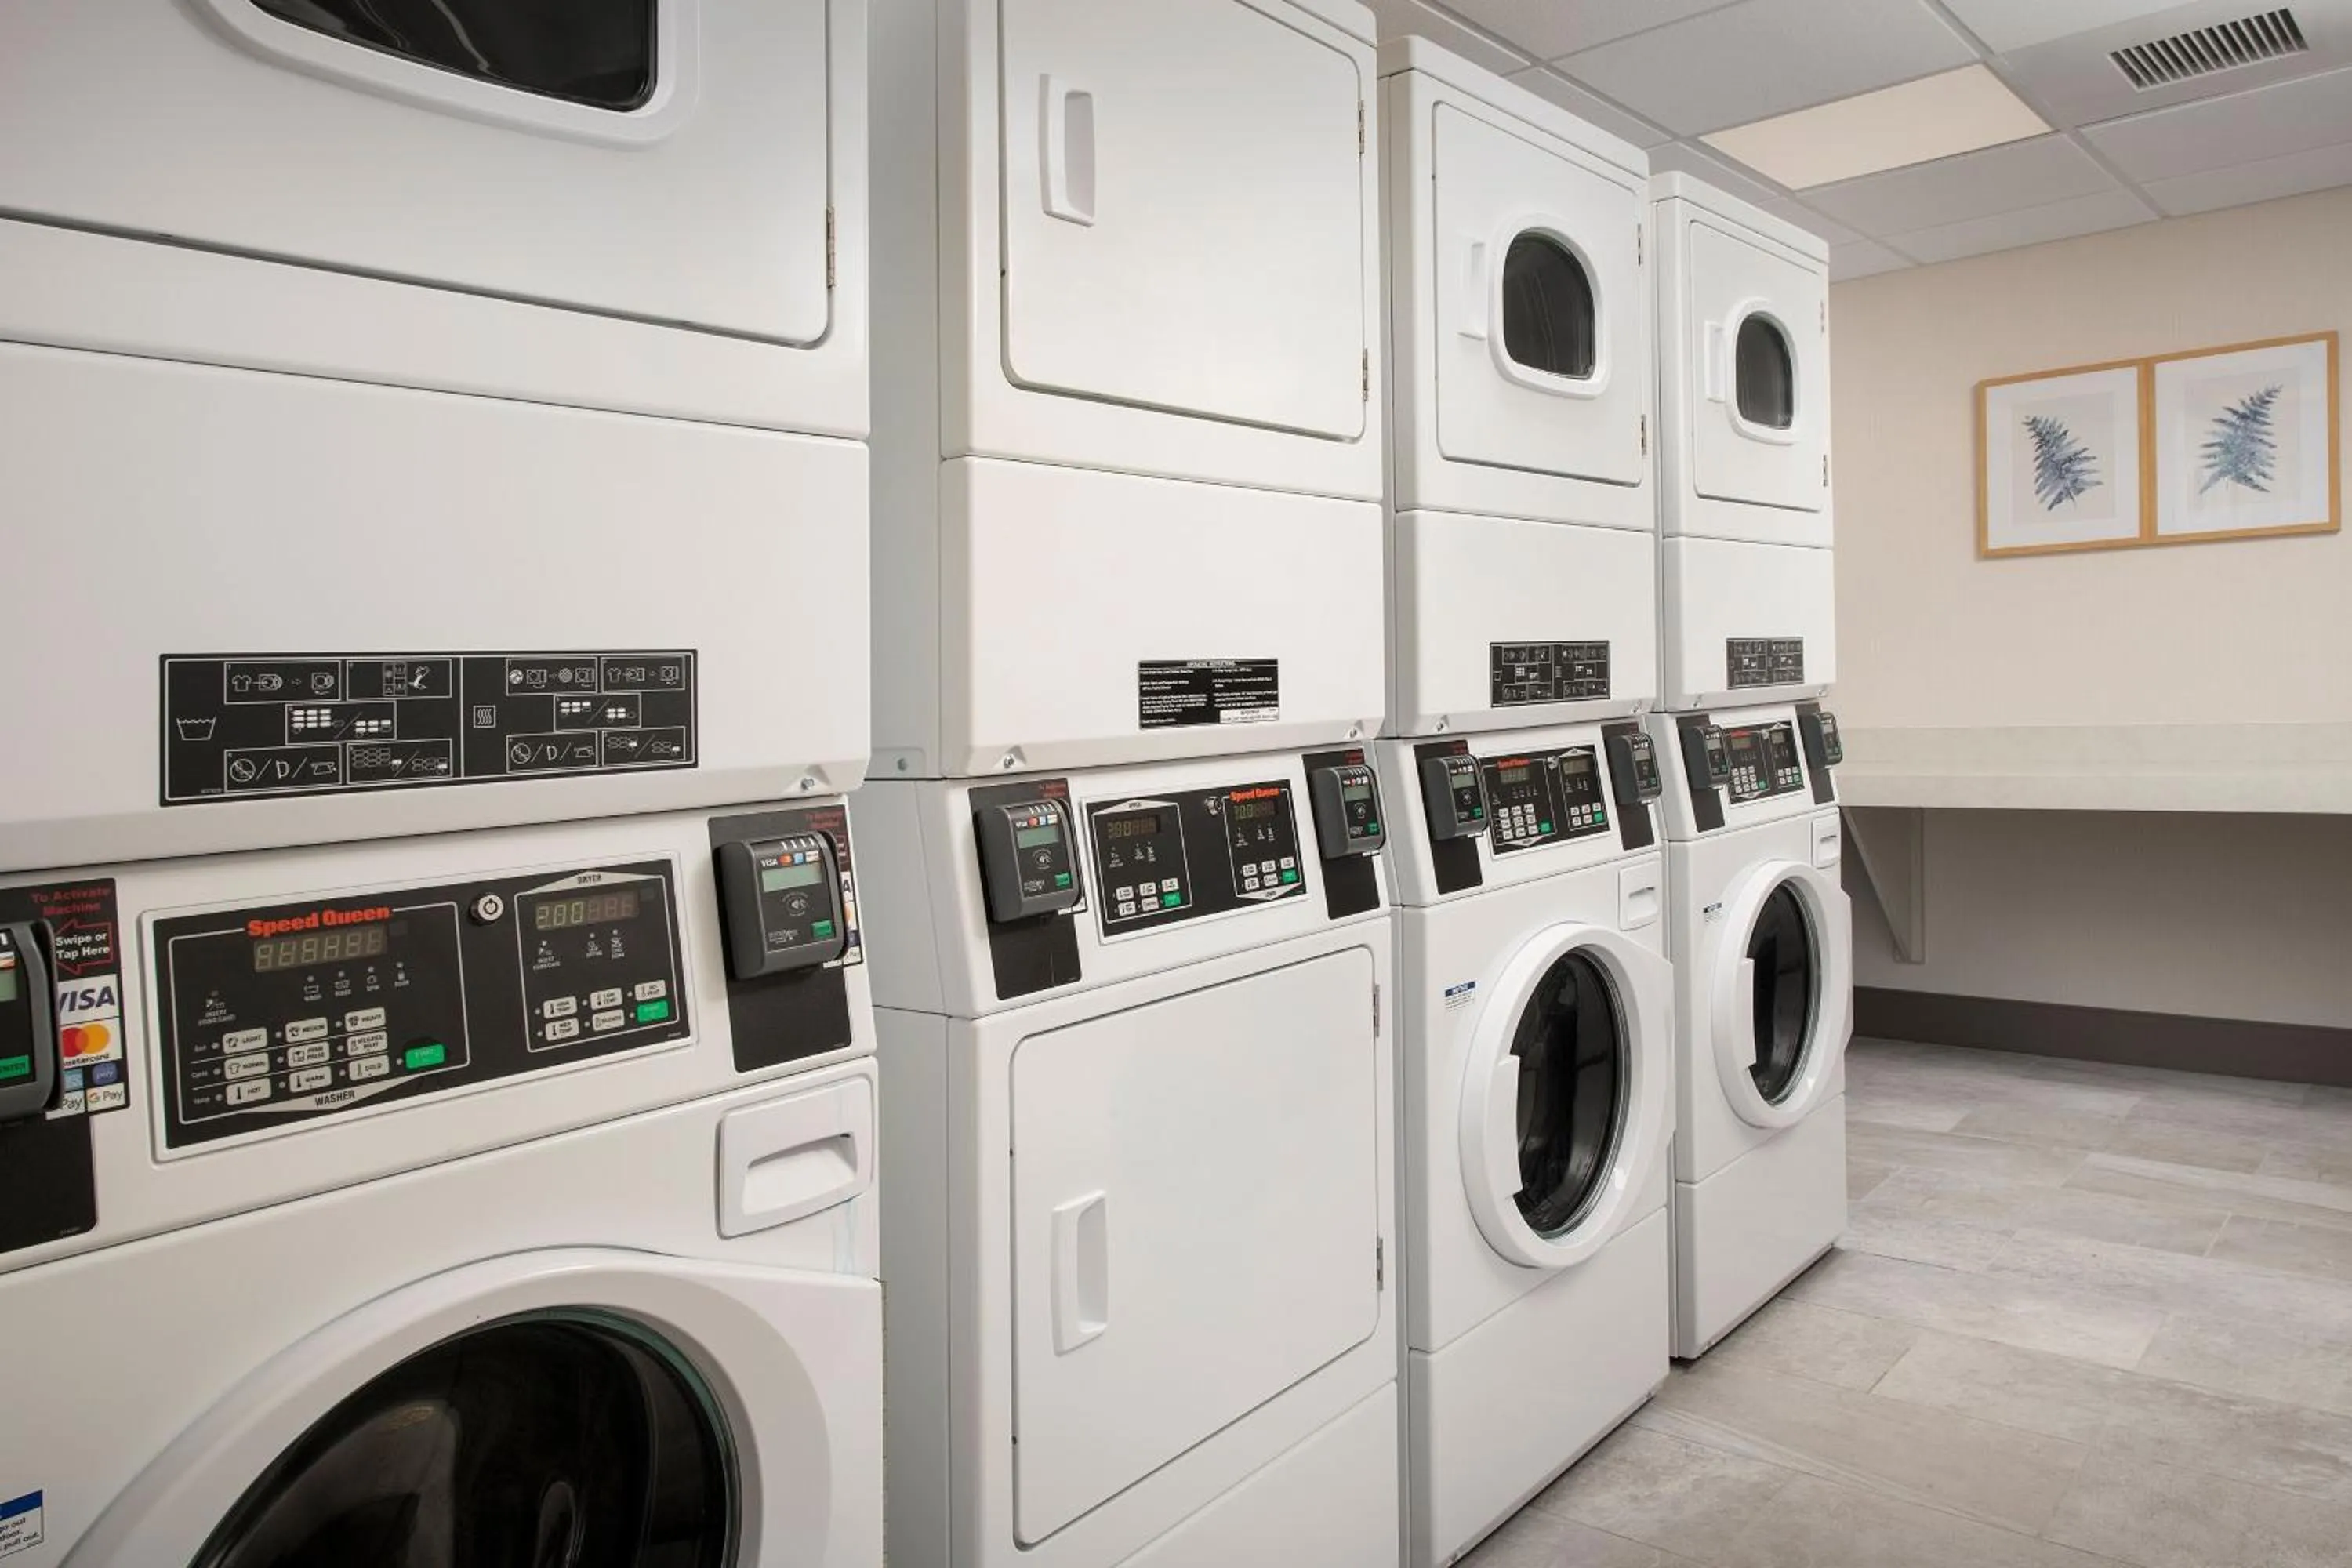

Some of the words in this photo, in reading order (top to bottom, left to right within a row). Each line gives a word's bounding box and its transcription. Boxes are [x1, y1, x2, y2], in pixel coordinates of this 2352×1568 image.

[577, 874, 602, 884] DRYER
[32, 893, 49, 902] To
[54, 887, 111, 900] Activate
[43, 903, 101, 916] Machine
[248, 912, 319, 937] Speed
[322, 906, 390, 926] Queen
[56, 935, 92, 946] Swipe
[95, 932, 107, 942] or
[56, 949, 78, 960] Tap
[82, 946, 111, 956] Here
[60, 985, 116, 1012] VISA
[64, 1053, 110, 1065] astercard
[103, 1091, 122, 1102] Pay
[248, 1086, 261, 1095] HOT
[63, 1098, 82, 1111] Pay
[315, 1090, 355, 1107] WASHER
